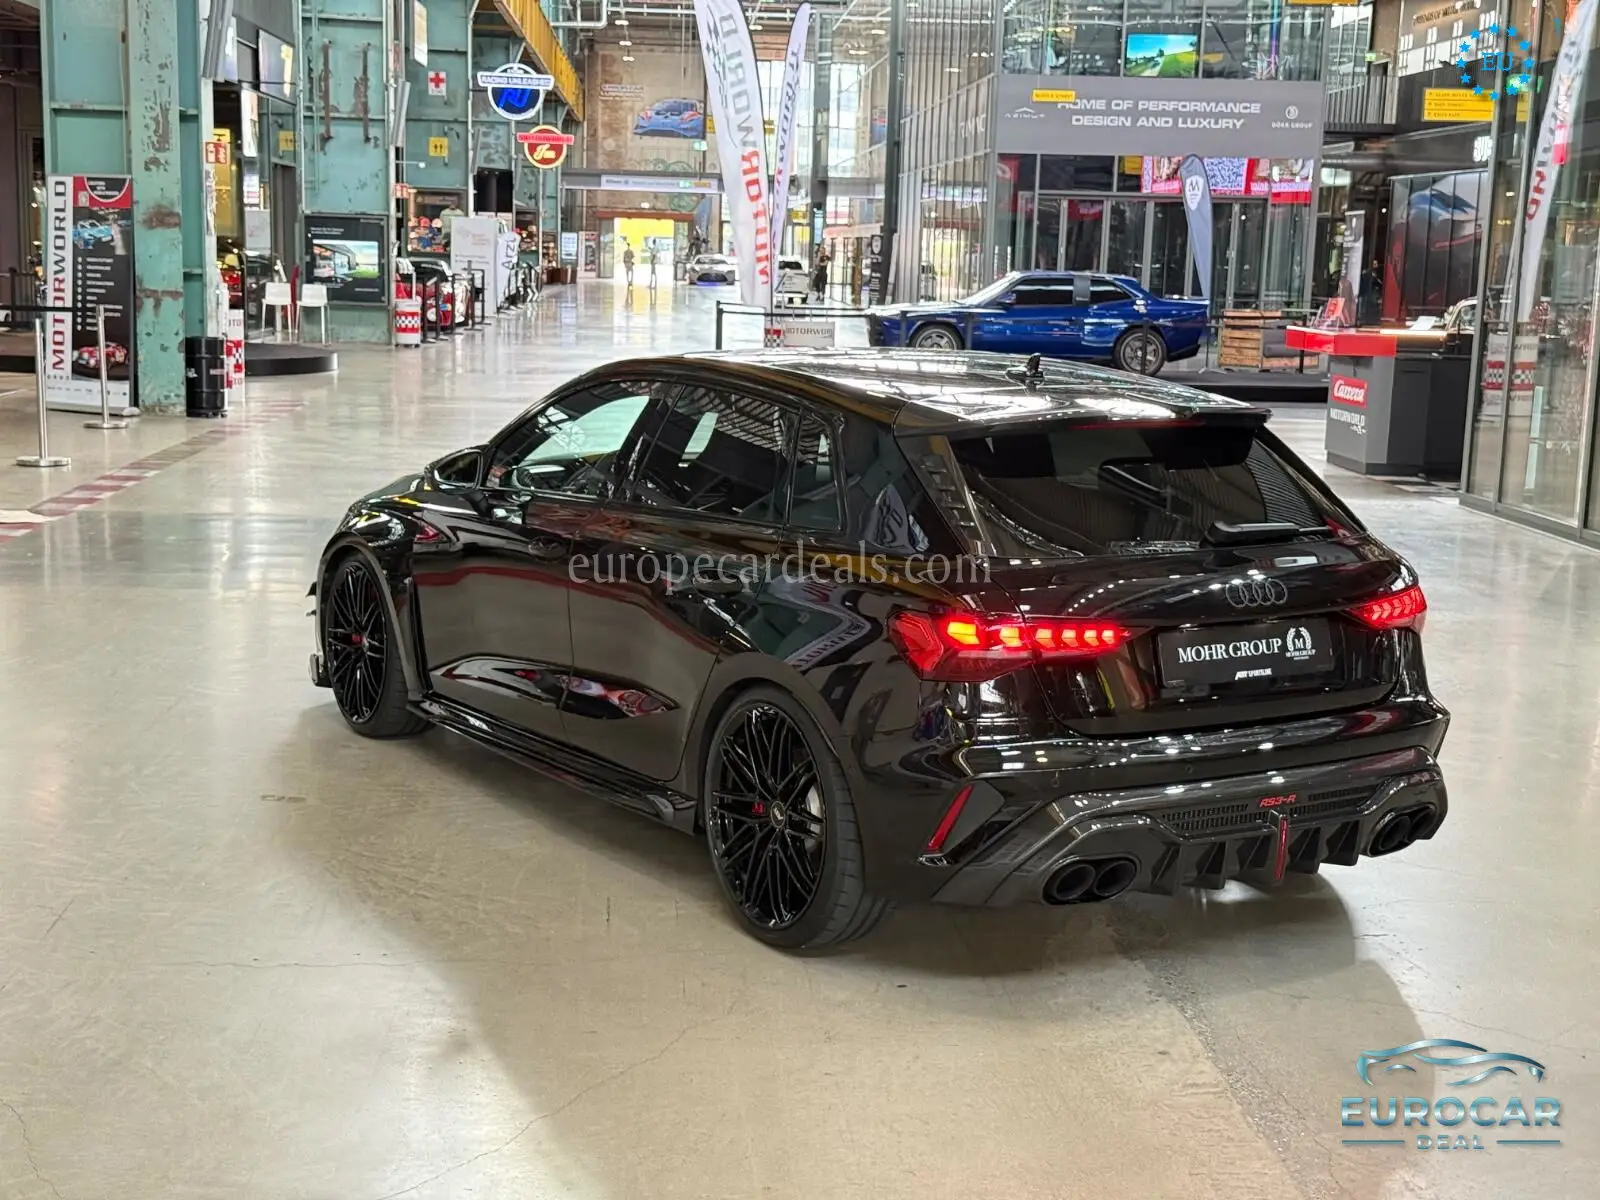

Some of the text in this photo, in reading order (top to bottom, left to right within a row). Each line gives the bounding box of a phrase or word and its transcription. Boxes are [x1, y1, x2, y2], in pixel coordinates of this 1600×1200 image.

[1057, 98, 1262, 114] HOME OF PERFORMANCE
[1071, 115, 1245, 129] DESIGN AND LUXURY
[51, 181, 67, 371] MOTORWORLD
[1334, 380, 1366, 403] Carrera
[1177, 638, 1281, 663] MOHR GROUP
[1295, 638, 1304, 649] M
[1260, 795, 1296, 807] RS3-R
